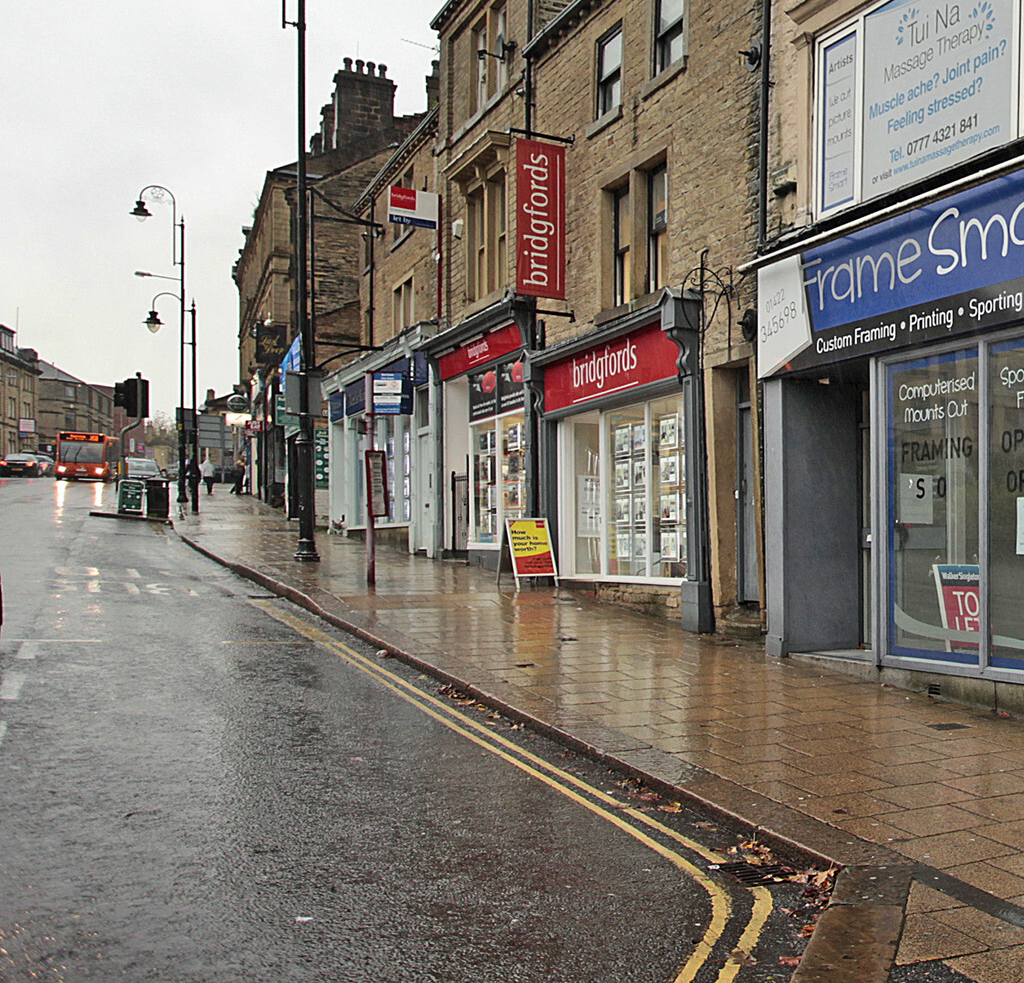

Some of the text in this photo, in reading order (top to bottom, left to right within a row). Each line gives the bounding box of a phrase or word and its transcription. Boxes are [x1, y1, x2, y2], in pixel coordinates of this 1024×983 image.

[907, 3, 959, 47] Tui Na
[828, 54, 853, 74] Artists
[883, 19, 986, 84] Massage Therapy
[840, 89, 851, 104] cut
[869, 39, 1007, 120] Muscle ache? Joint pain?
[828, 108, 852, 127] picture
[887, 76, 983, 134] Feeling stressed?
[827, 128, 852, 146] mounts
[872, 123, 1000, 184] or visit www.tuinamassagetherapy.com
[889, 113, 978, 164] Tel. 0777 4321 841
[523, 154, 554, 286] bridgfords
[800, 238, 921, 310] Frame
[761, 301, 797, 343] 345698
[766, 289, 785, 313] 01422
[816, 327, 853, 354] Custom
[854, 321, 896, 349] Framing
[909, 309, 953, 333] Printing
[969, 291, 1023, 319] Sporting
[573, 338, 637, 388] bridgfords
[899, 372, 975, 402] Computerised
[904, 400, 968, 423] Mounts Cut
[901, 436, 973, 462] FRAMING
[953, 591, 979, 616] TO
